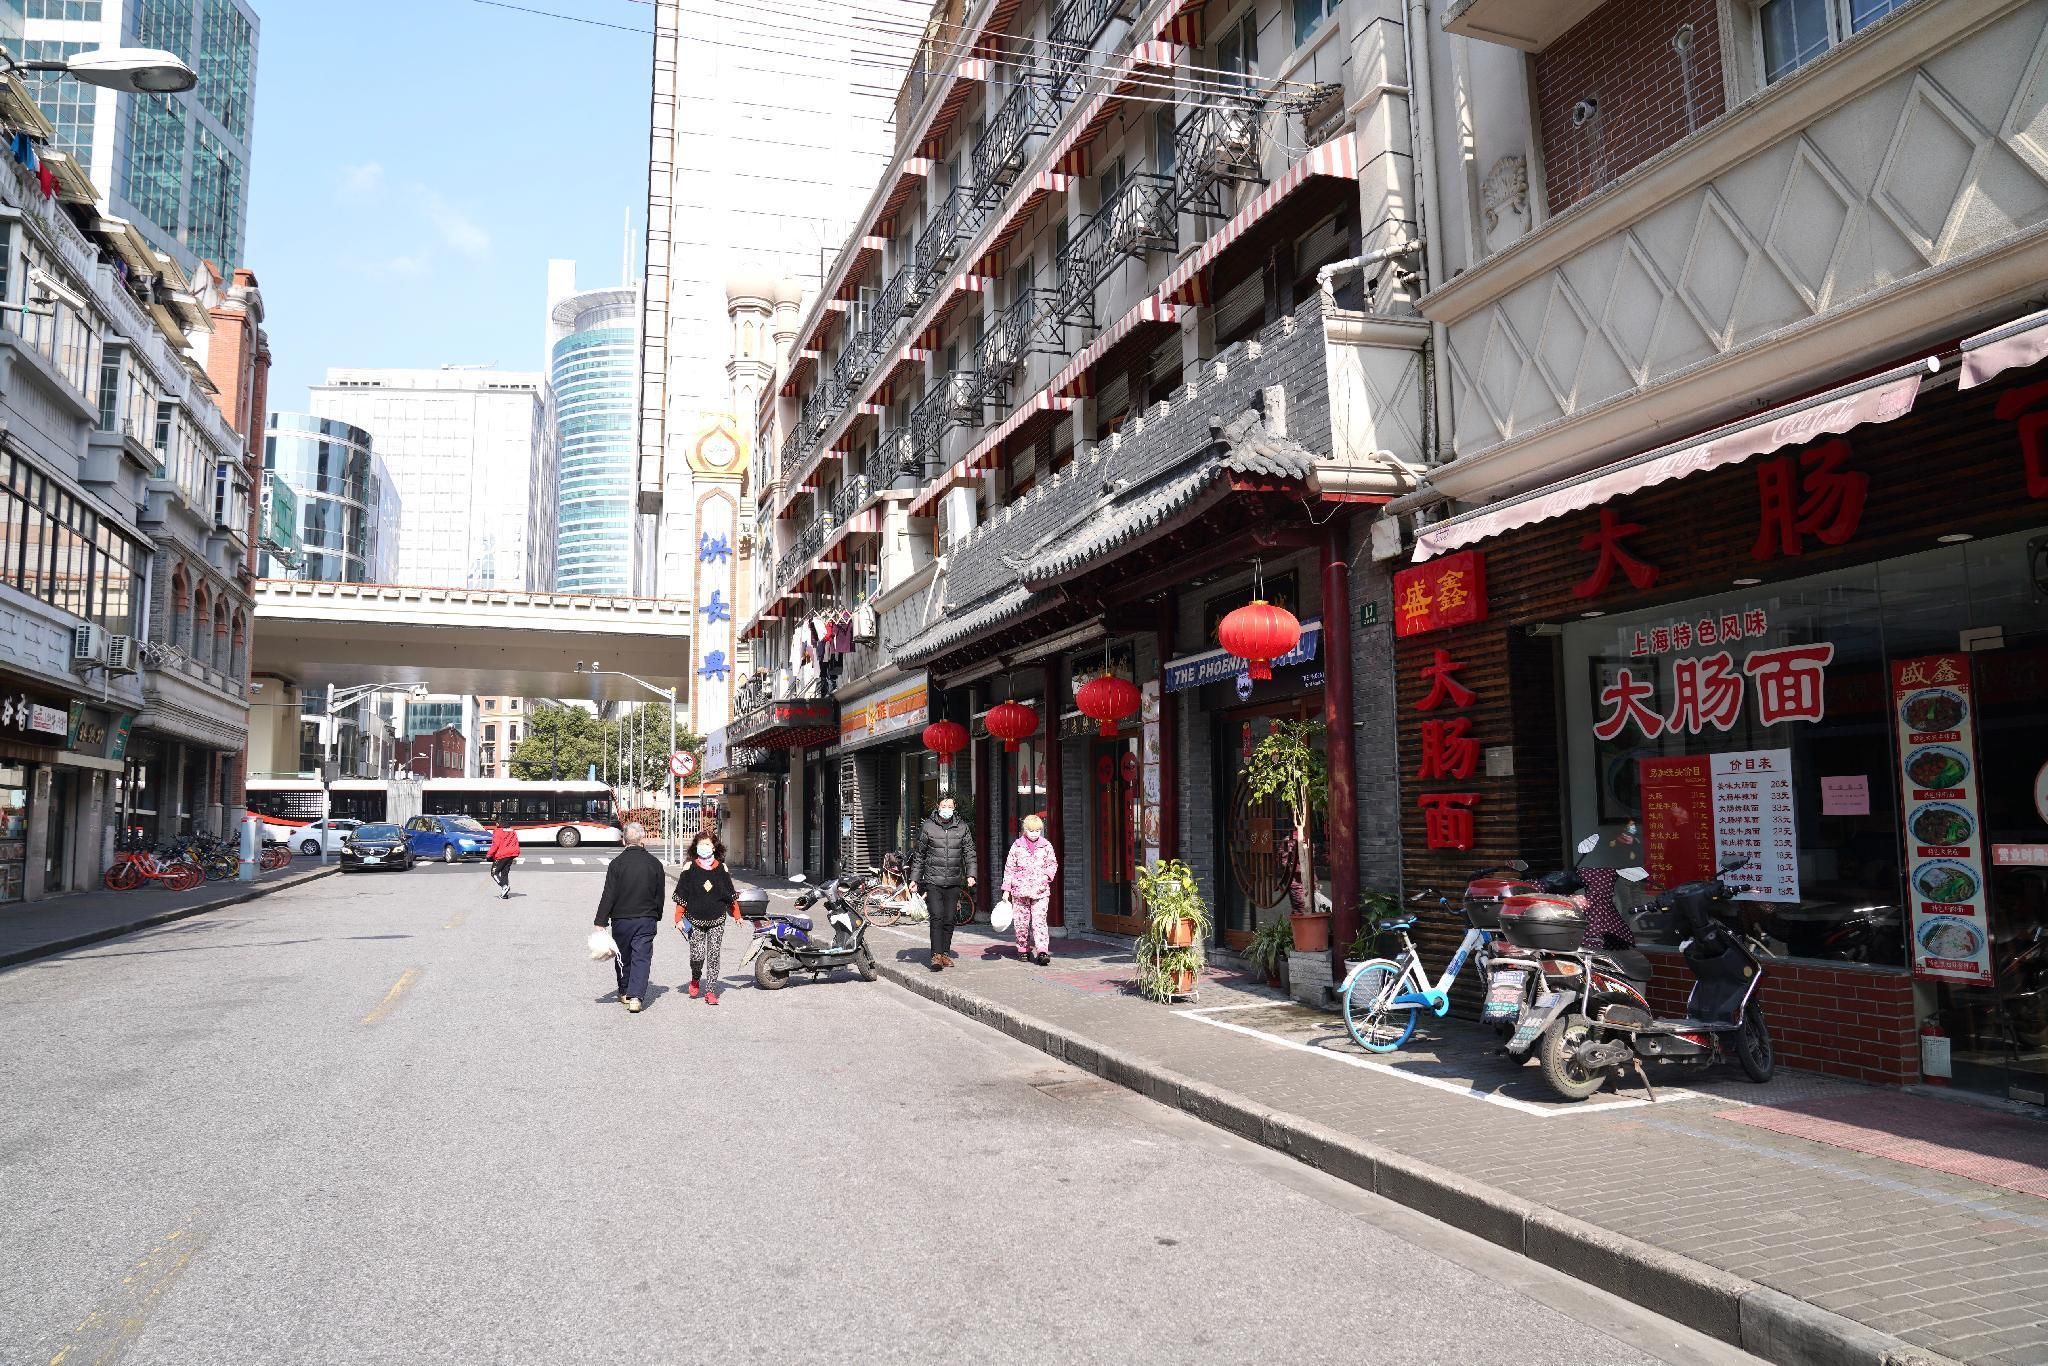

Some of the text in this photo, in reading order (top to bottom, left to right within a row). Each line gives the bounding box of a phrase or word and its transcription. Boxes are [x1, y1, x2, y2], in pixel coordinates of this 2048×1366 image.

[1402, 568, 1469, 621] 盛鑫
[1630, 607, 1768, 658] 上海特色风味
[1174, 656, 1249, 684] THE PHOENIX
[1594, 641, 1834, 740] 大肠面
[1901, 658, 1961, 685] 盛鑫
[1416, 648, 1480, 851] 大肠面
[1730, 757, 1772, 771] 价目表
